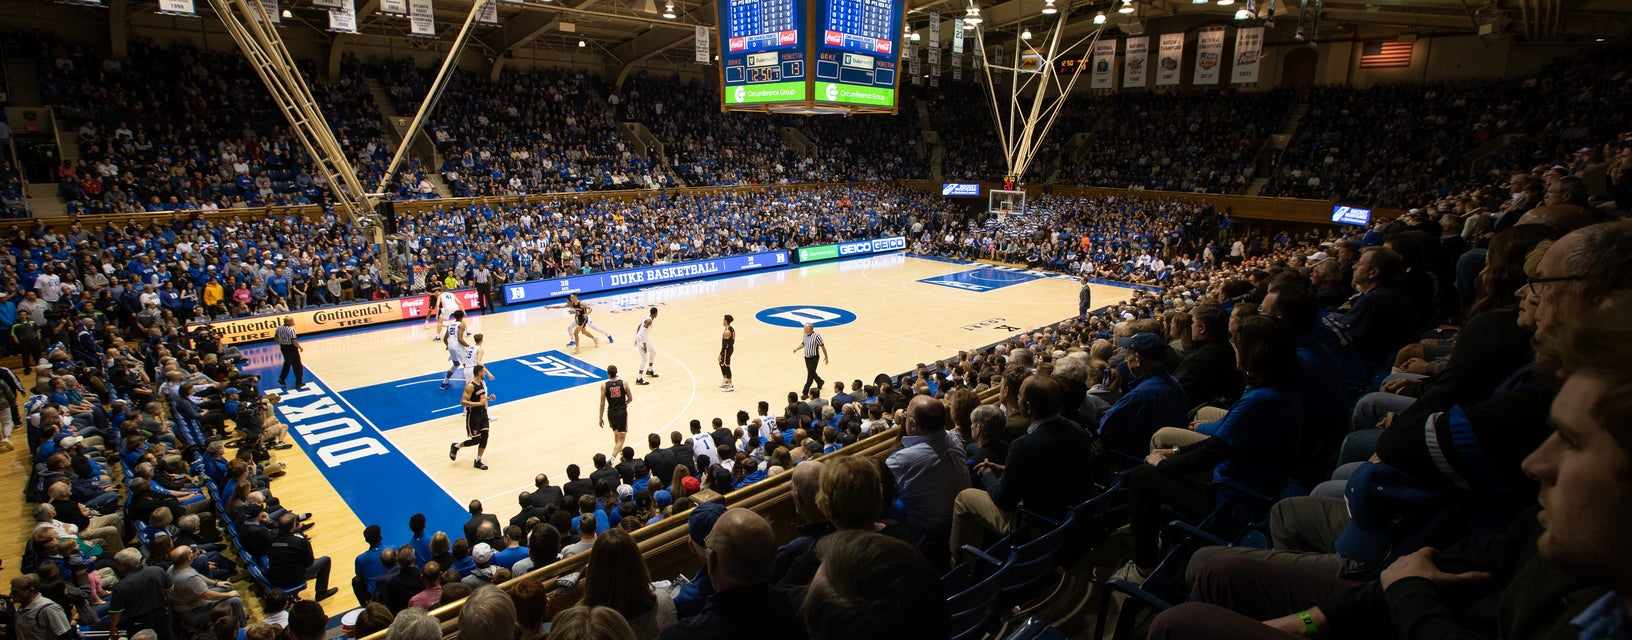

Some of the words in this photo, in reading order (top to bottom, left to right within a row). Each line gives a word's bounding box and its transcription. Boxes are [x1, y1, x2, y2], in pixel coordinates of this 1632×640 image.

[791, 62, 800, 76] 13
[780, 88, 795, 96] Group
[840, 243, 871, 254] GEICO
[874, 238, 904, 250] GEICO
[610, 272, 644, 286] DUKE
[647, 262, 718, 281] BASKETBALL
[313, 304, 382, 325] Continental
[214, 318, 282, 336] ntinental
[337, 317, 373, 327] TIRE
[228, 332, 270, 342] TIRE
[264, 382, 390, 468] DUKE
